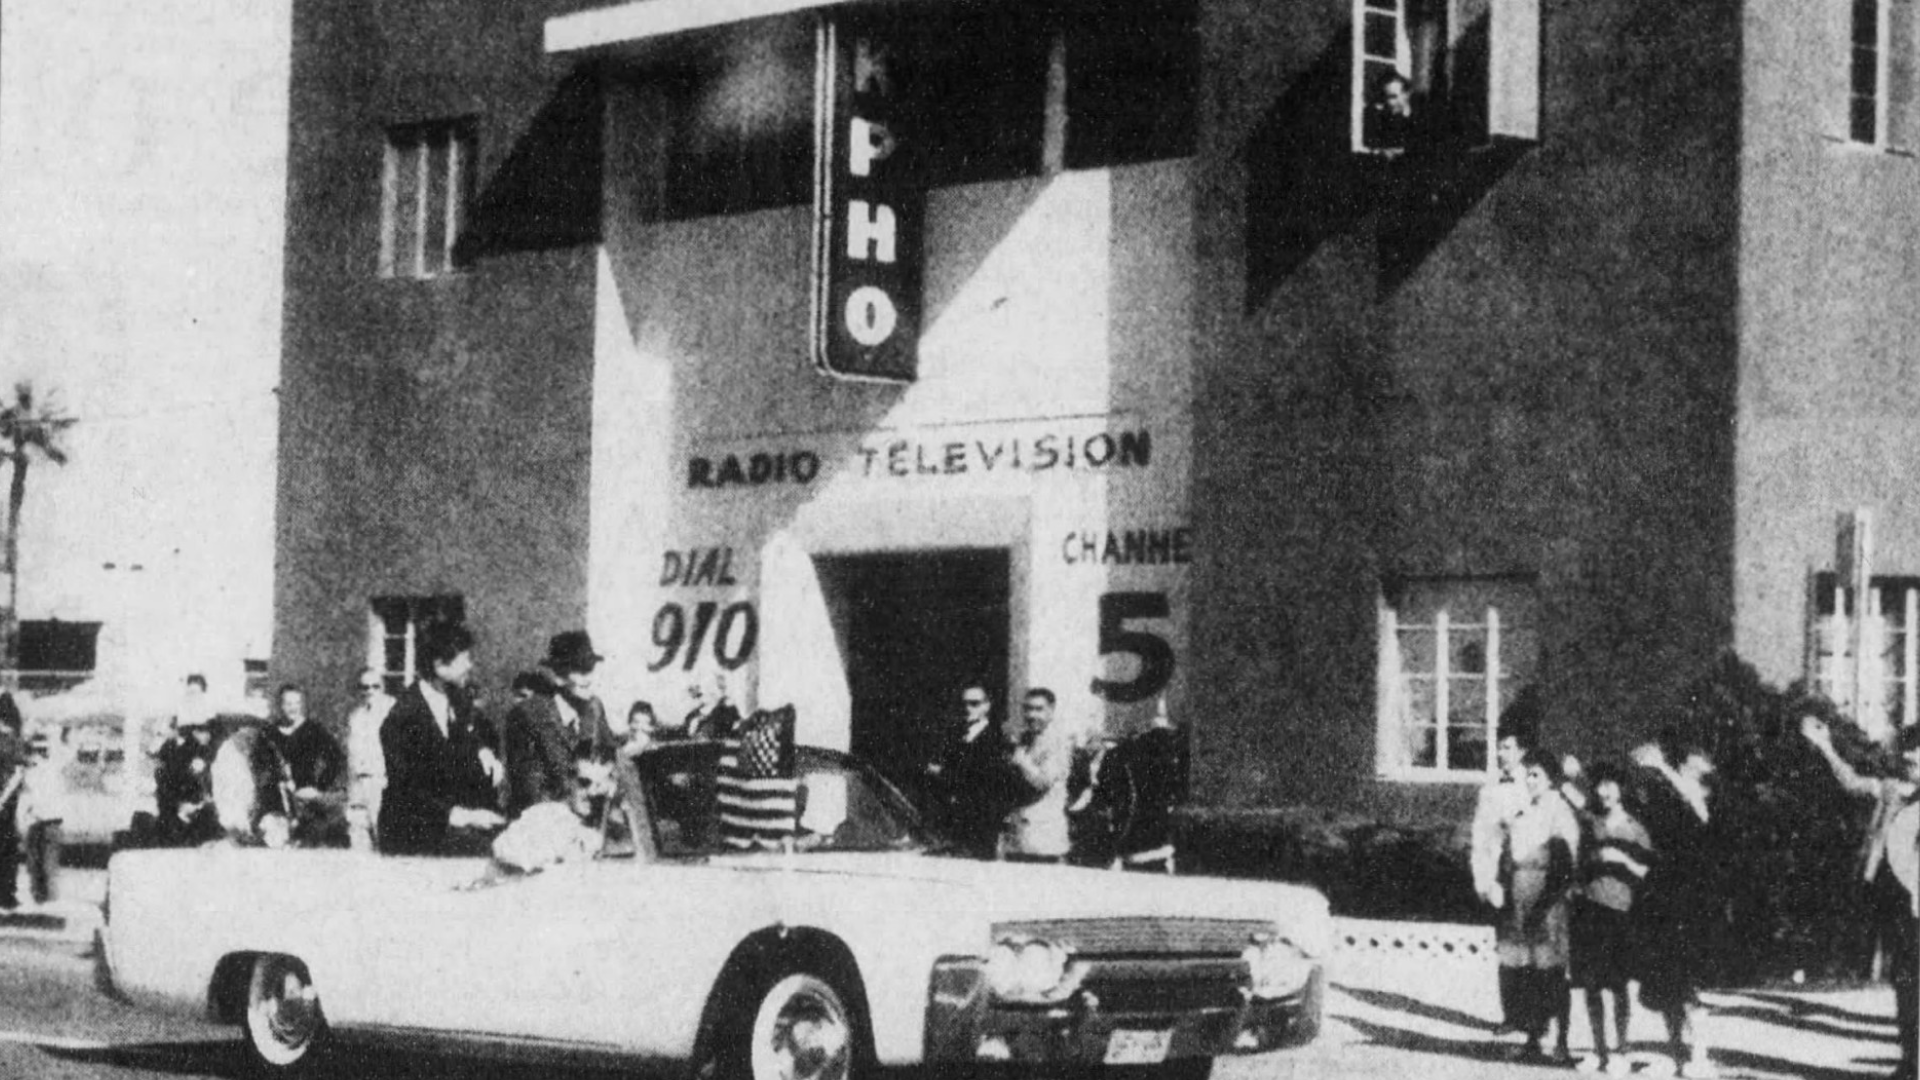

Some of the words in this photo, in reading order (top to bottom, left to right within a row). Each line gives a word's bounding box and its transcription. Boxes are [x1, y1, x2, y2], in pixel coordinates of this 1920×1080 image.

[687, 450, 820, 489] RADIO
[857, 429, 1152, 477] TELEVISION
[659, 547, 736, 587] DIAL
[1062, 526, 1192, 566] CHANNE
[646, 600, 760, 672] 910
[1090, 591, 1176, 704] 5
